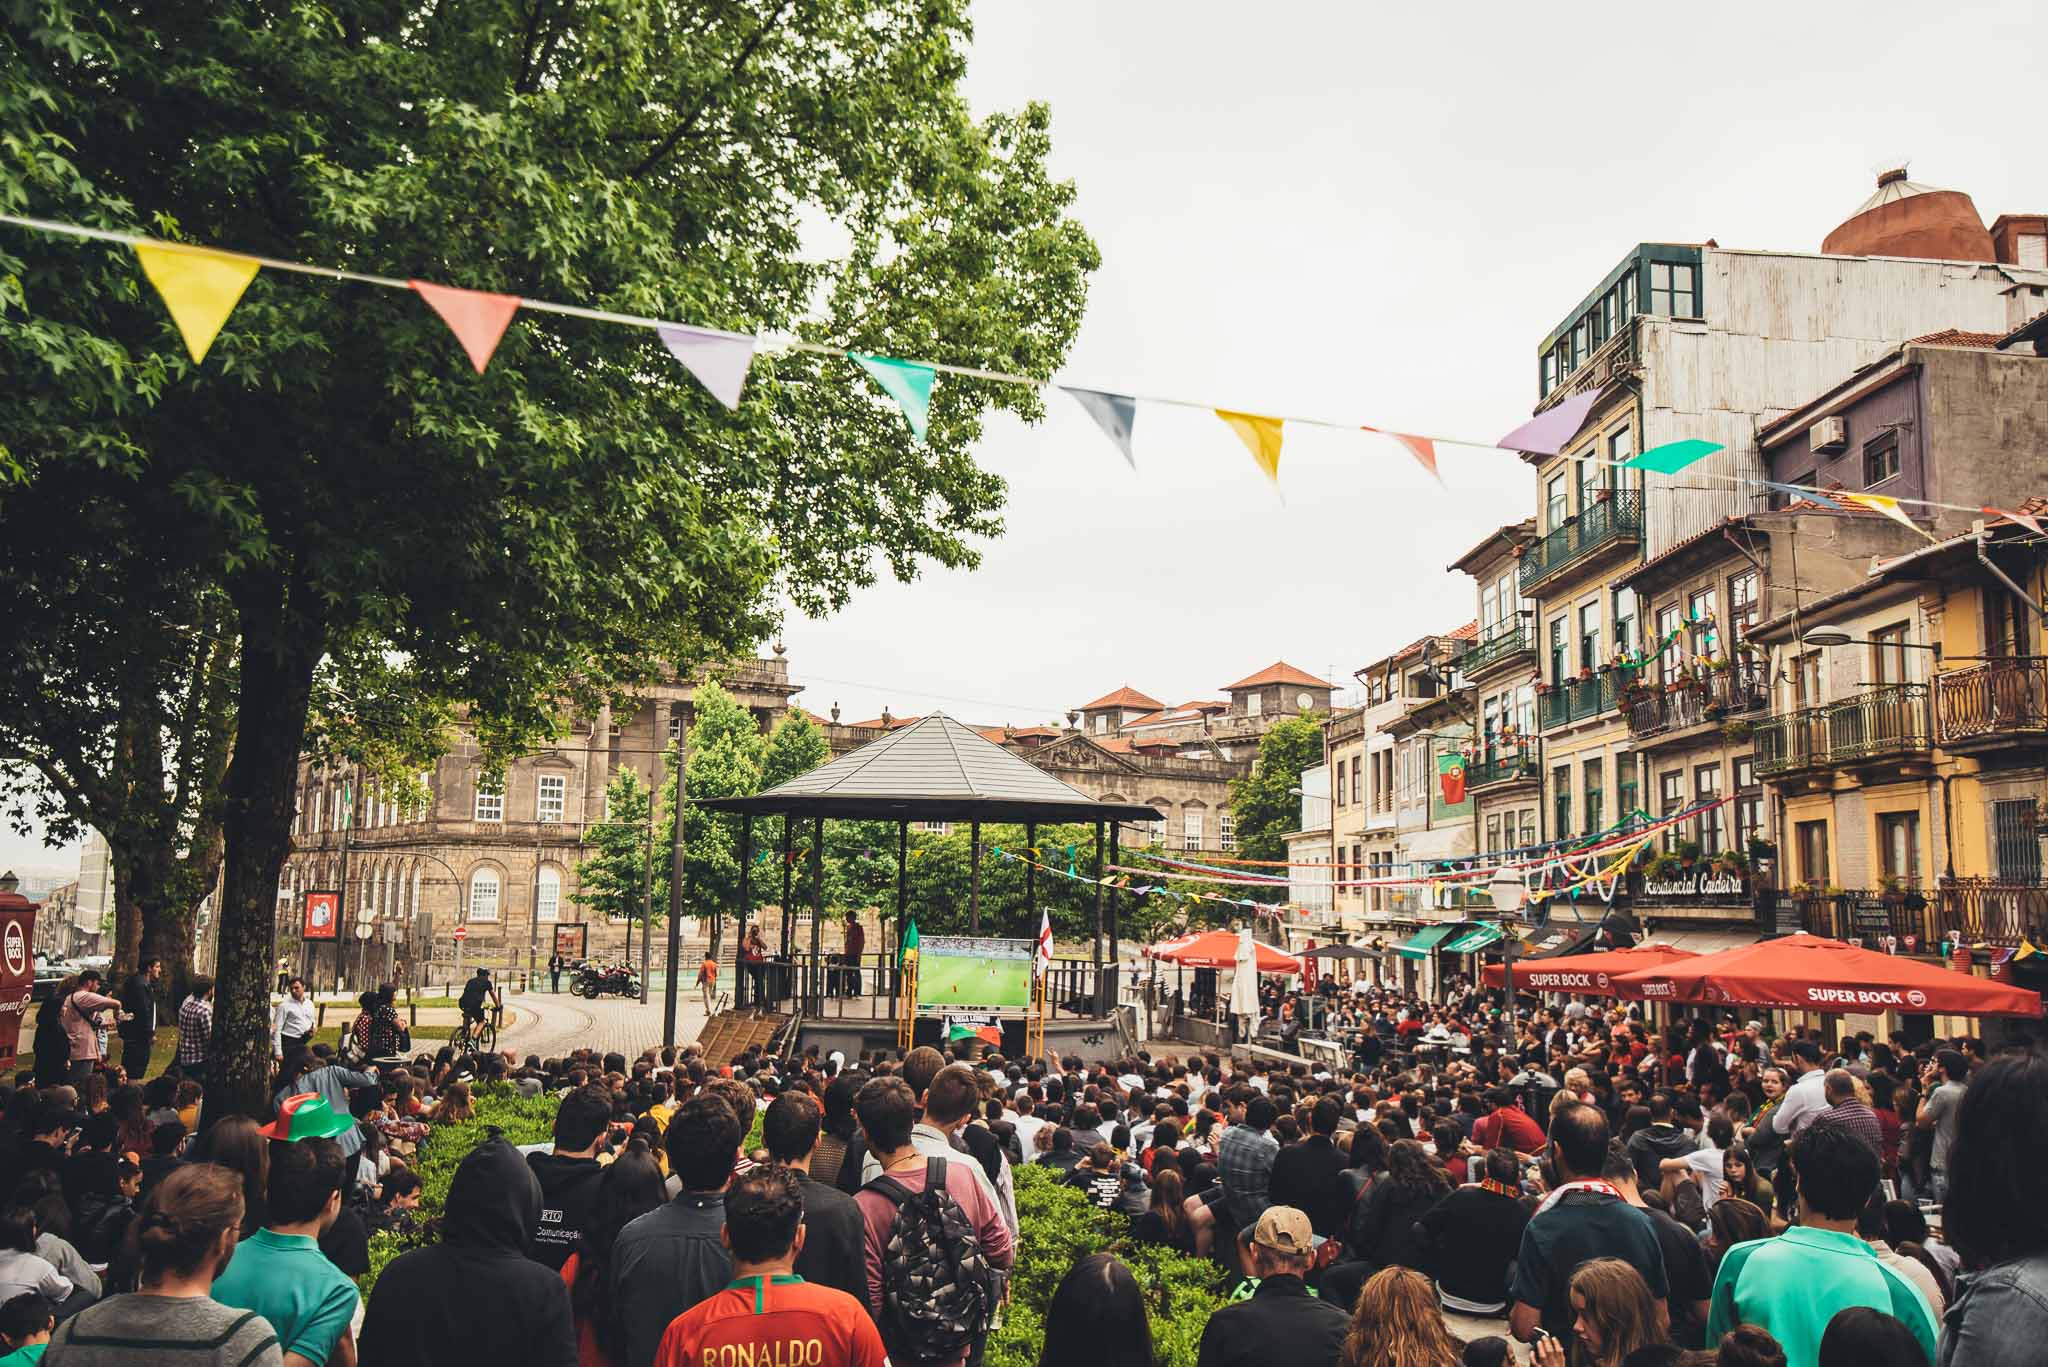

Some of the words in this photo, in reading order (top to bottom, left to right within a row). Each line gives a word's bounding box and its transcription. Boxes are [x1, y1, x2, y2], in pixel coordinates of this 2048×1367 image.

[7, 936, 22, 948] SUPER
[8, 948, 22, 959] BOCK
[1529, 973, 1562, 987] SUPER
[1562, 974, 1591, 987] BOCK
[1807, 987, 1857, 1003] SUPER
[1859, 990, 1903, 1005] BOCK
[703, 1338, 823, 1367] RONALDO
